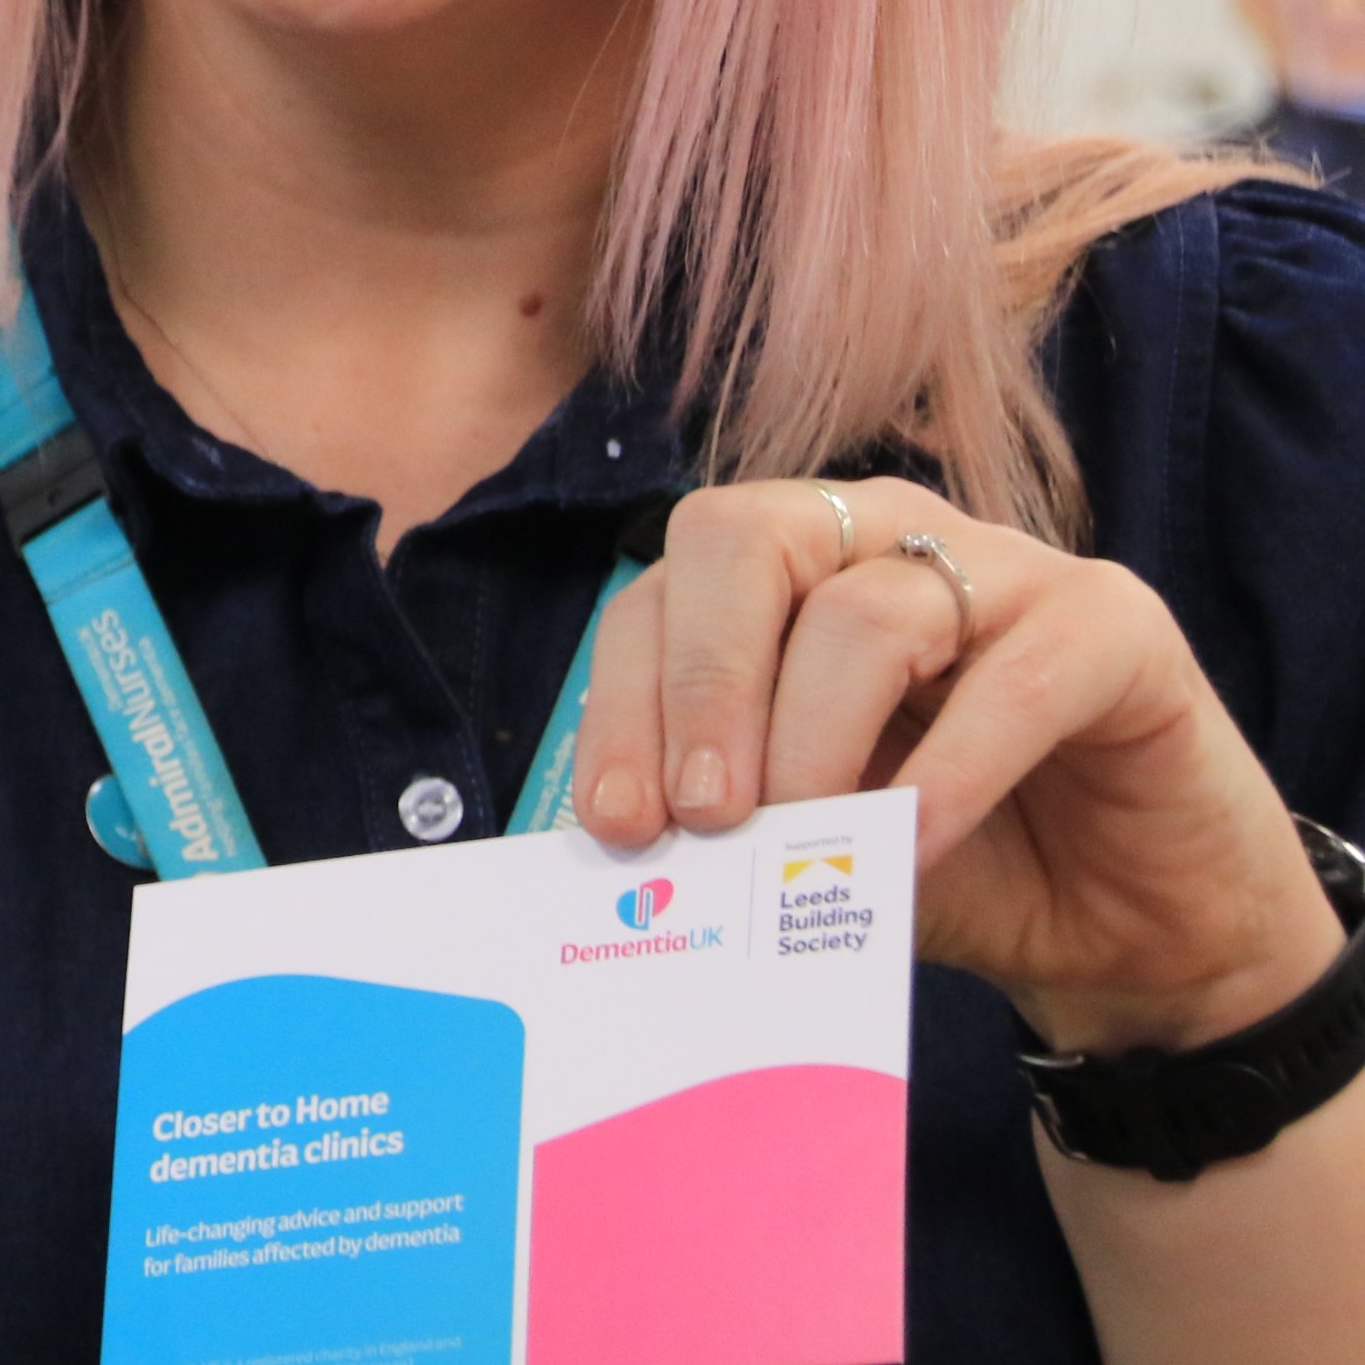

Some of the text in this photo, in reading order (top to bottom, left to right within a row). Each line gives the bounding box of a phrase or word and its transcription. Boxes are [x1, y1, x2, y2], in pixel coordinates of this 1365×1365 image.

[91, 608, 219, 862] AdmiralNurses
[779, 906, 874, 933] Building
[780, 885, 851, 909] Leeds
[560, 925, 725, 965] DementiaUK
[777, 931, 868, 956] Society
[152, 1091, 390, 1142] Closer to Home
[149, 1127, 404, 1183] dementia clinics
[145, 1193, 464, 1248] Life-changing advice and support
[143, 1223, 461, 1277] for families affected by dementia
